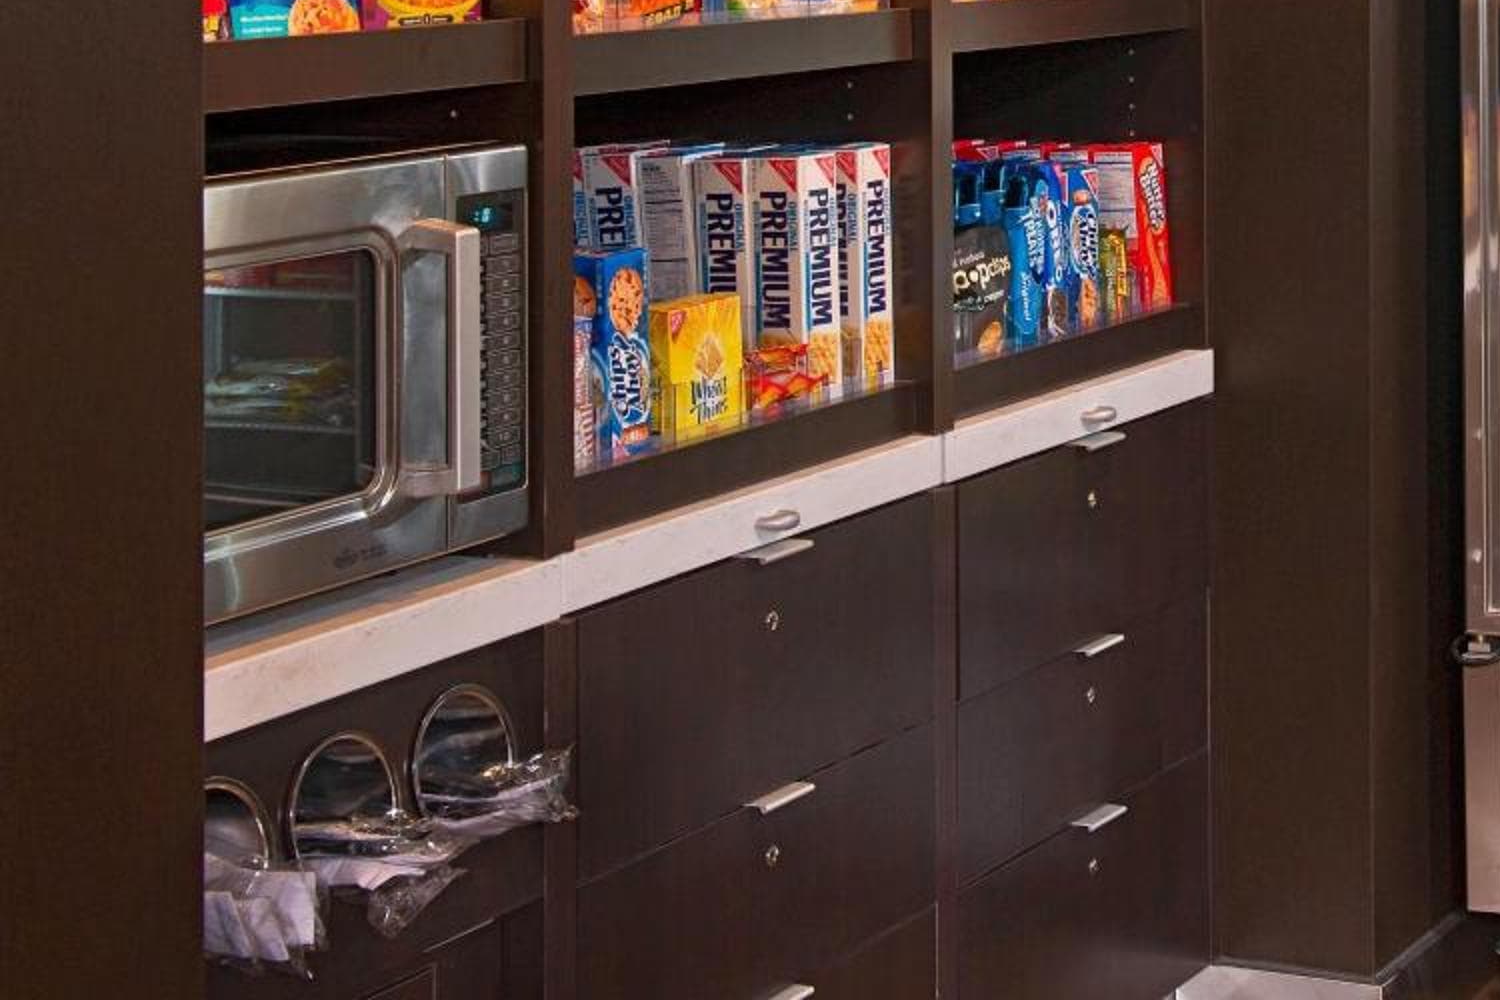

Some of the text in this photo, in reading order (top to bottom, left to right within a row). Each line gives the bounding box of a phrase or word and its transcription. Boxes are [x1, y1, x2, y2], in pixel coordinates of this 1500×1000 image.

[706, 193, 738, 293] PREMIU
[759, 191, 791, 330] PREMIUM
[808, 188, 833, 327] PREMIUM
[866, 179, 887, 314] PREMIUM
